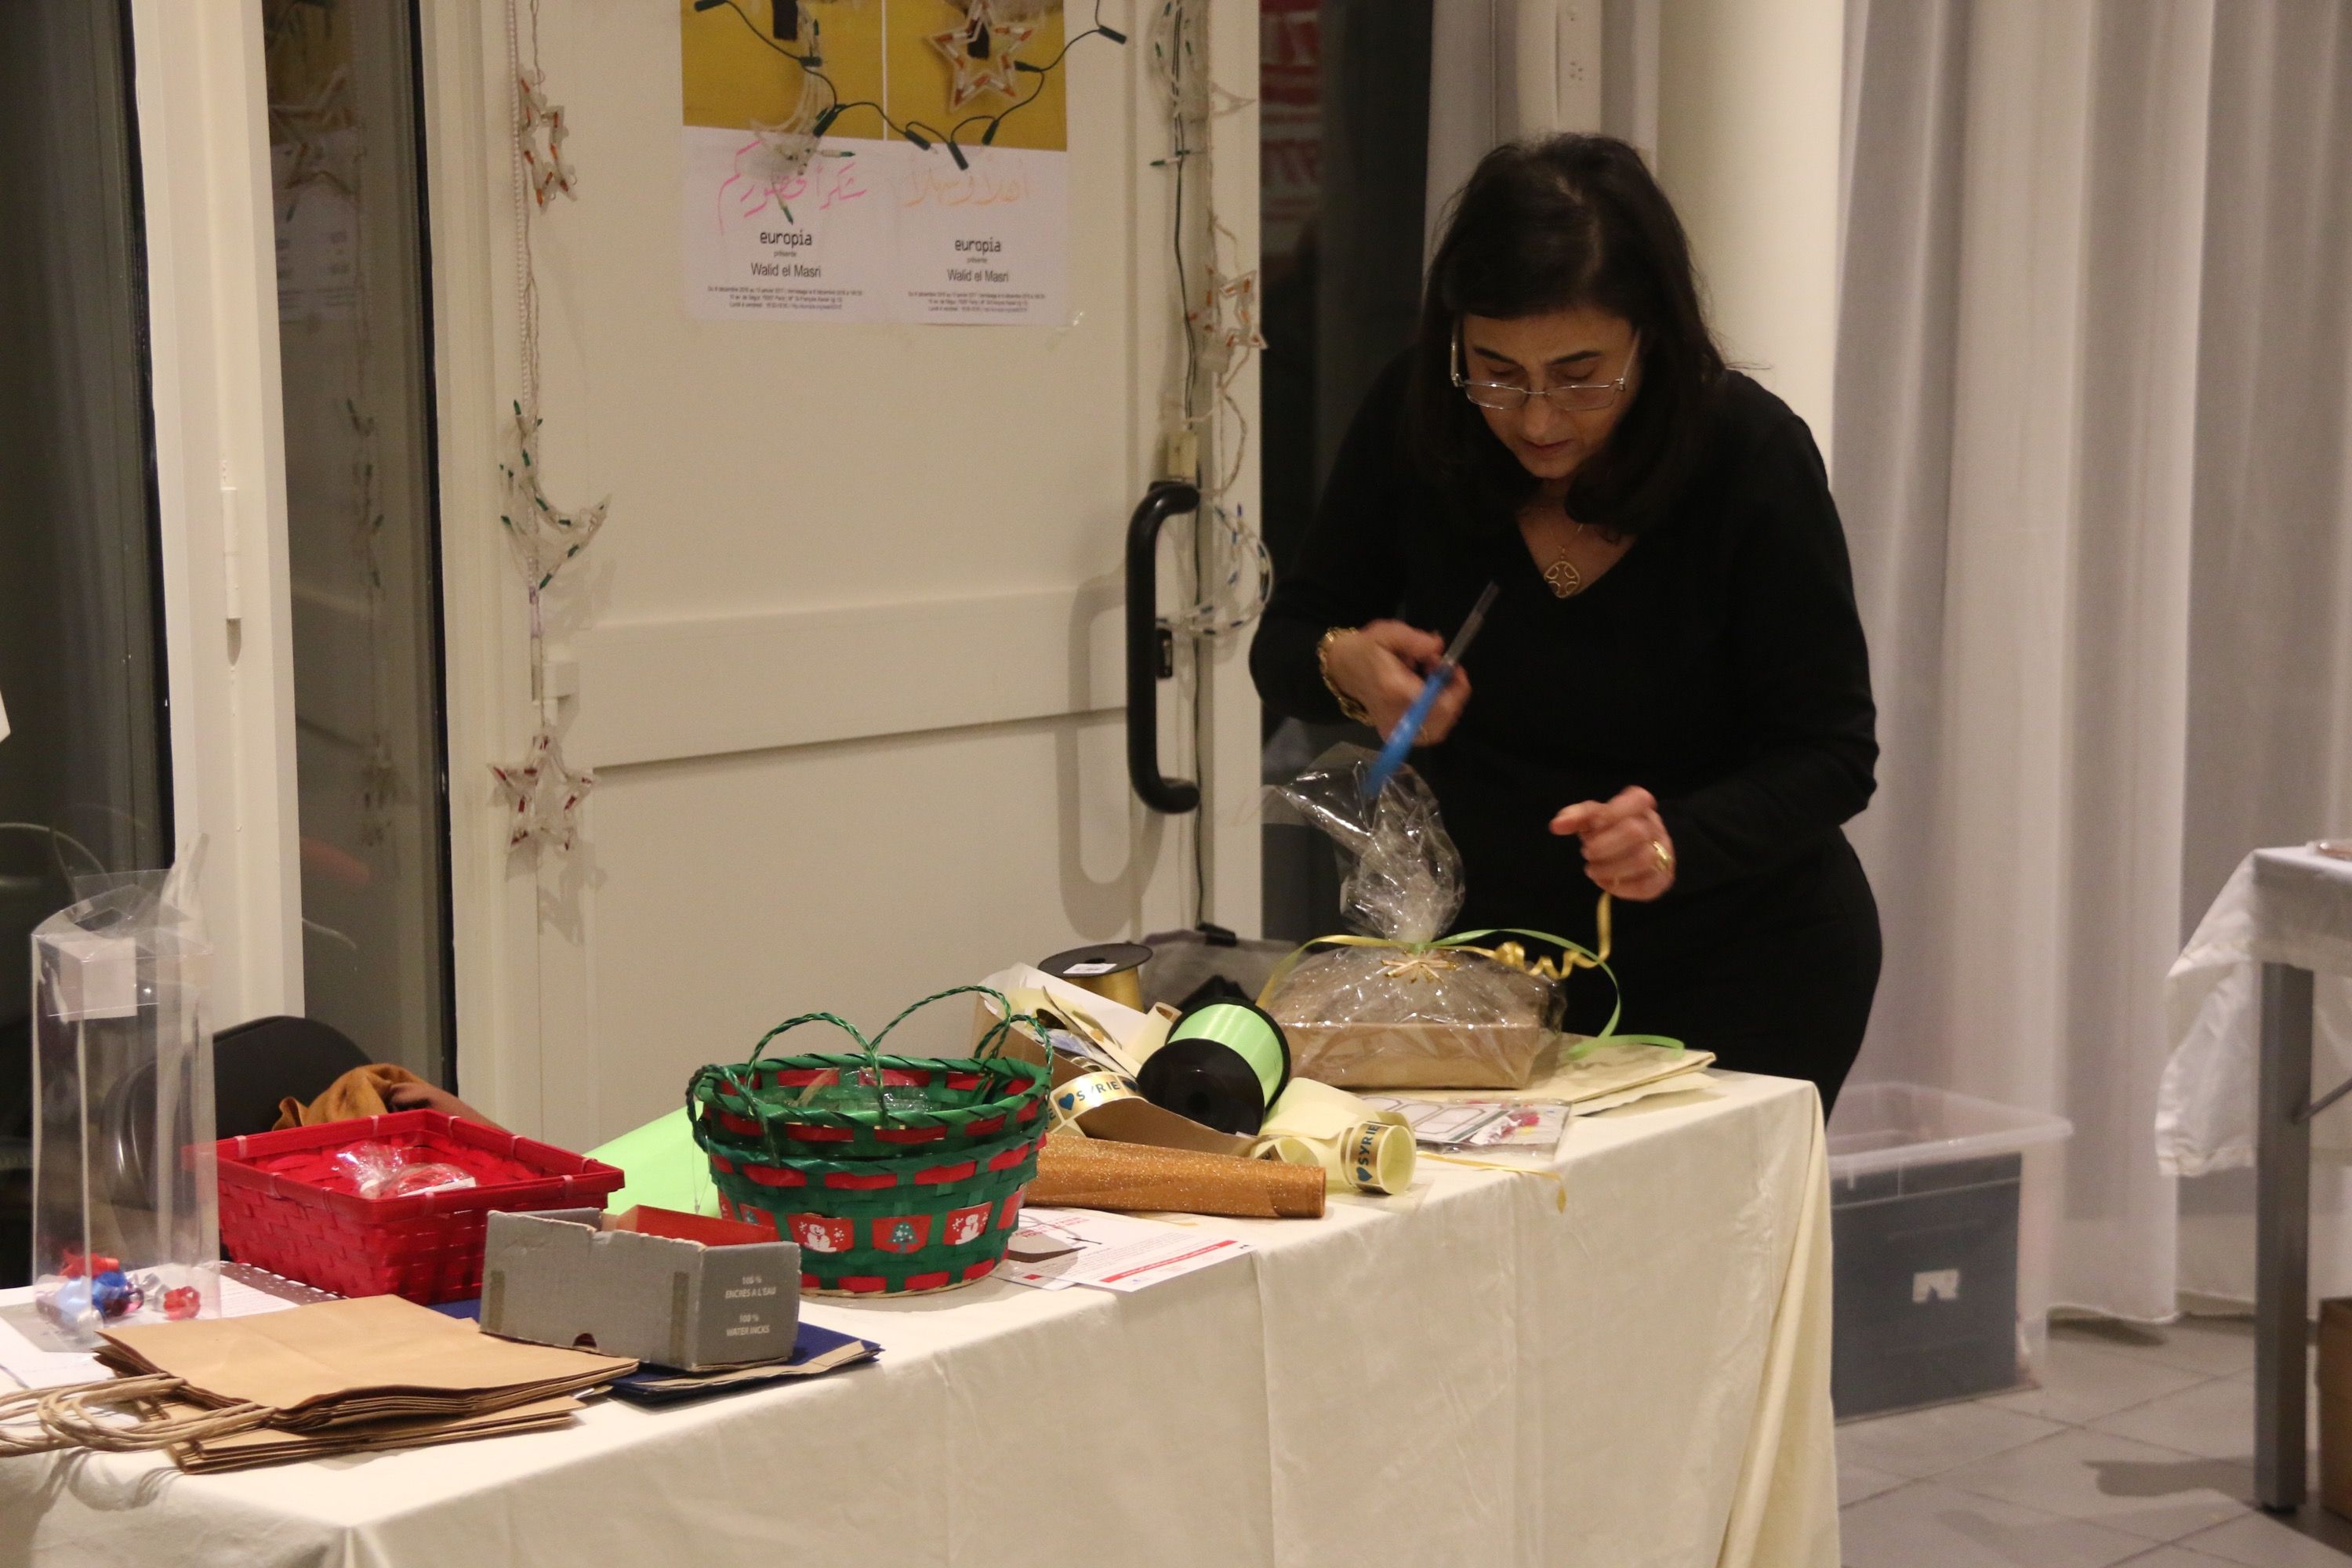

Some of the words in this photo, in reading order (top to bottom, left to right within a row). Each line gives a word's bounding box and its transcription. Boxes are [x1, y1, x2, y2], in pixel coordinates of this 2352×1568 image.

[750, 263, 779, 277] Walid
[782, 264, 790, 277] el
[794, 264, 822, 278] Masri
[947, 269, 971, 281] Walid
[975, 270, 982, 281] el
[985, 270, 1009, 282] Masri
[1076, 1081, 1120, 1102] SRIE
[1357, 1123, 1381, 1166] SYRIE
